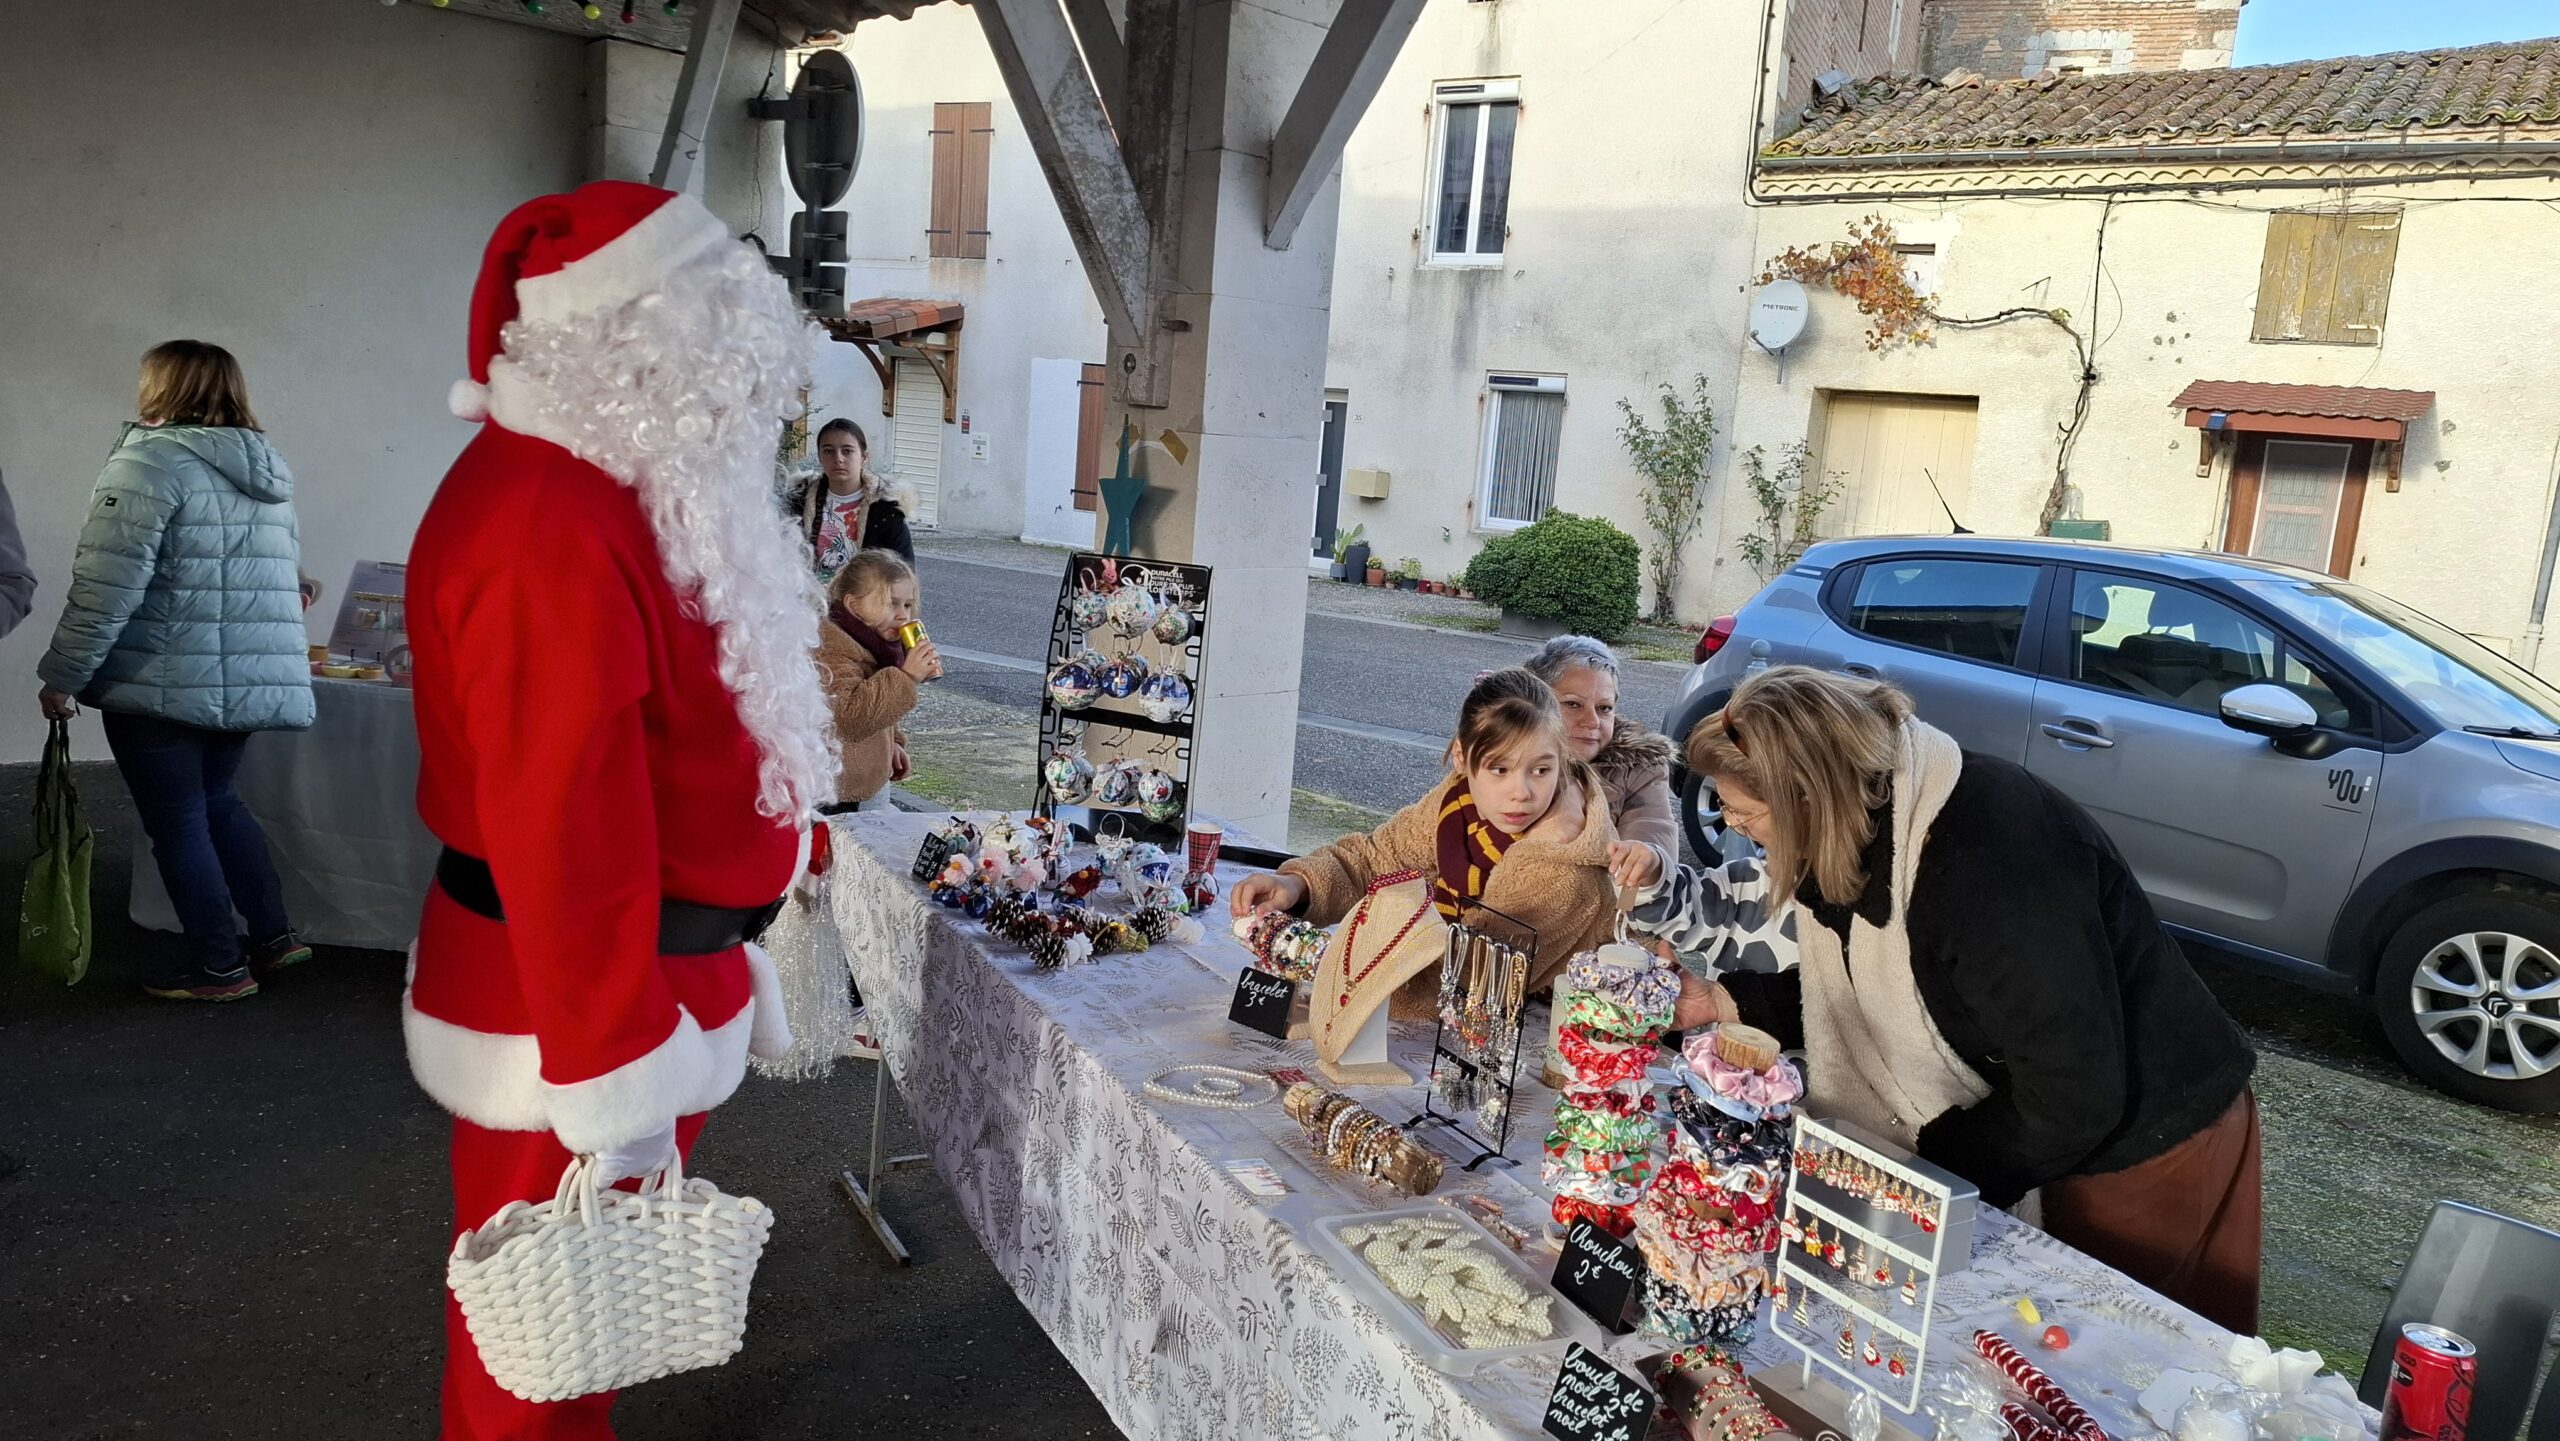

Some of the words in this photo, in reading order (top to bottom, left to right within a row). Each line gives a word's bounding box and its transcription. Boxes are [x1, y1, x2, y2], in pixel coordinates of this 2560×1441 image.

[1762, 303, 1800, 312] METRONIC
[1780, 443, 1790, 451] 37
[1150, 569, 1184, 579] DURACELL
[1240, 971, 1288, 999] bracelet
[1564, 1346, 1620, 1396] boucles
[1623, 1388, 1644, 1412] de
